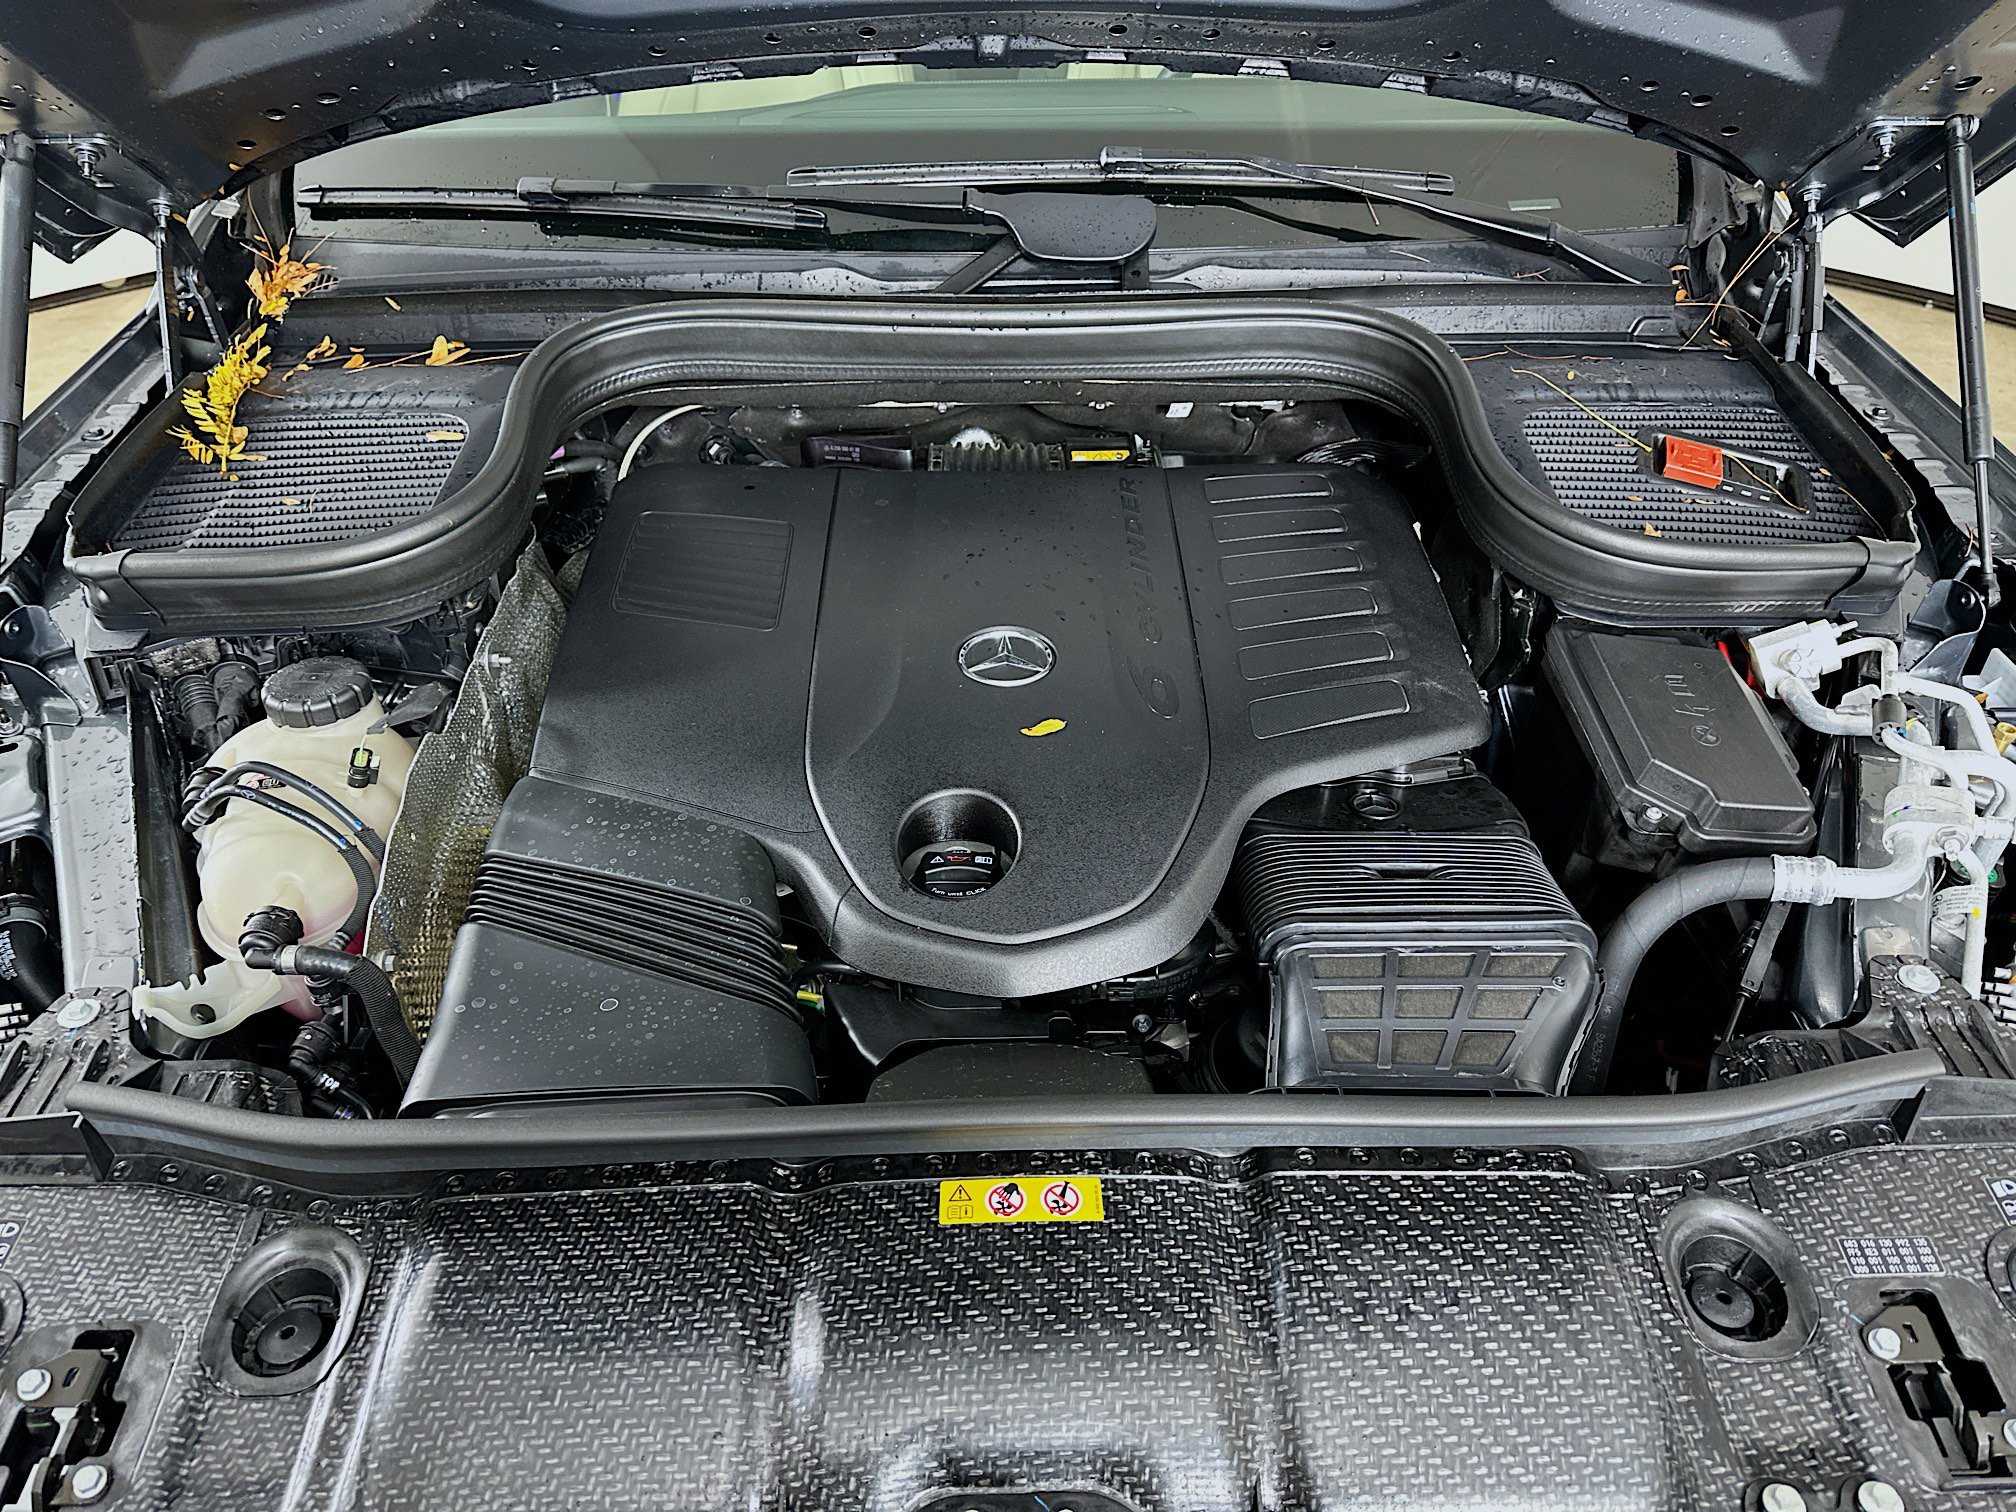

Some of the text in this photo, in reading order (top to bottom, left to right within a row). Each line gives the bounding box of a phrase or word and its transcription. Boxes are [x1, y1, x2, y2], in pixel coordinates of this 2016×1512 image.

[1119, 476, 1163, 644] CYLINDER
[931, 887, 945, 895] Turn
[965, 887, 987, 896] CLICK
[319, 1073, 341, 1090] TOP
[1860, 1239, 1875, 1247] 016
[1878, 1238, 1892, 1247] 130
[1895, 1238, 1910, 1247] 992
[1881, 1247, 1896, 1256] 011
[1899, 1247, 1913, 1255] 001
[1917, 1246, 1931, 1255] 100
[1850, 1255, 1935, 1265] 010 001 100 101 000
[1853, 1265, 1869, 1273] 000
[1872, 1264, 1886, 1273] 111
[1889, 1264, 1904, 1273] 011
[1906, 1264, 1921, 1273] 001
